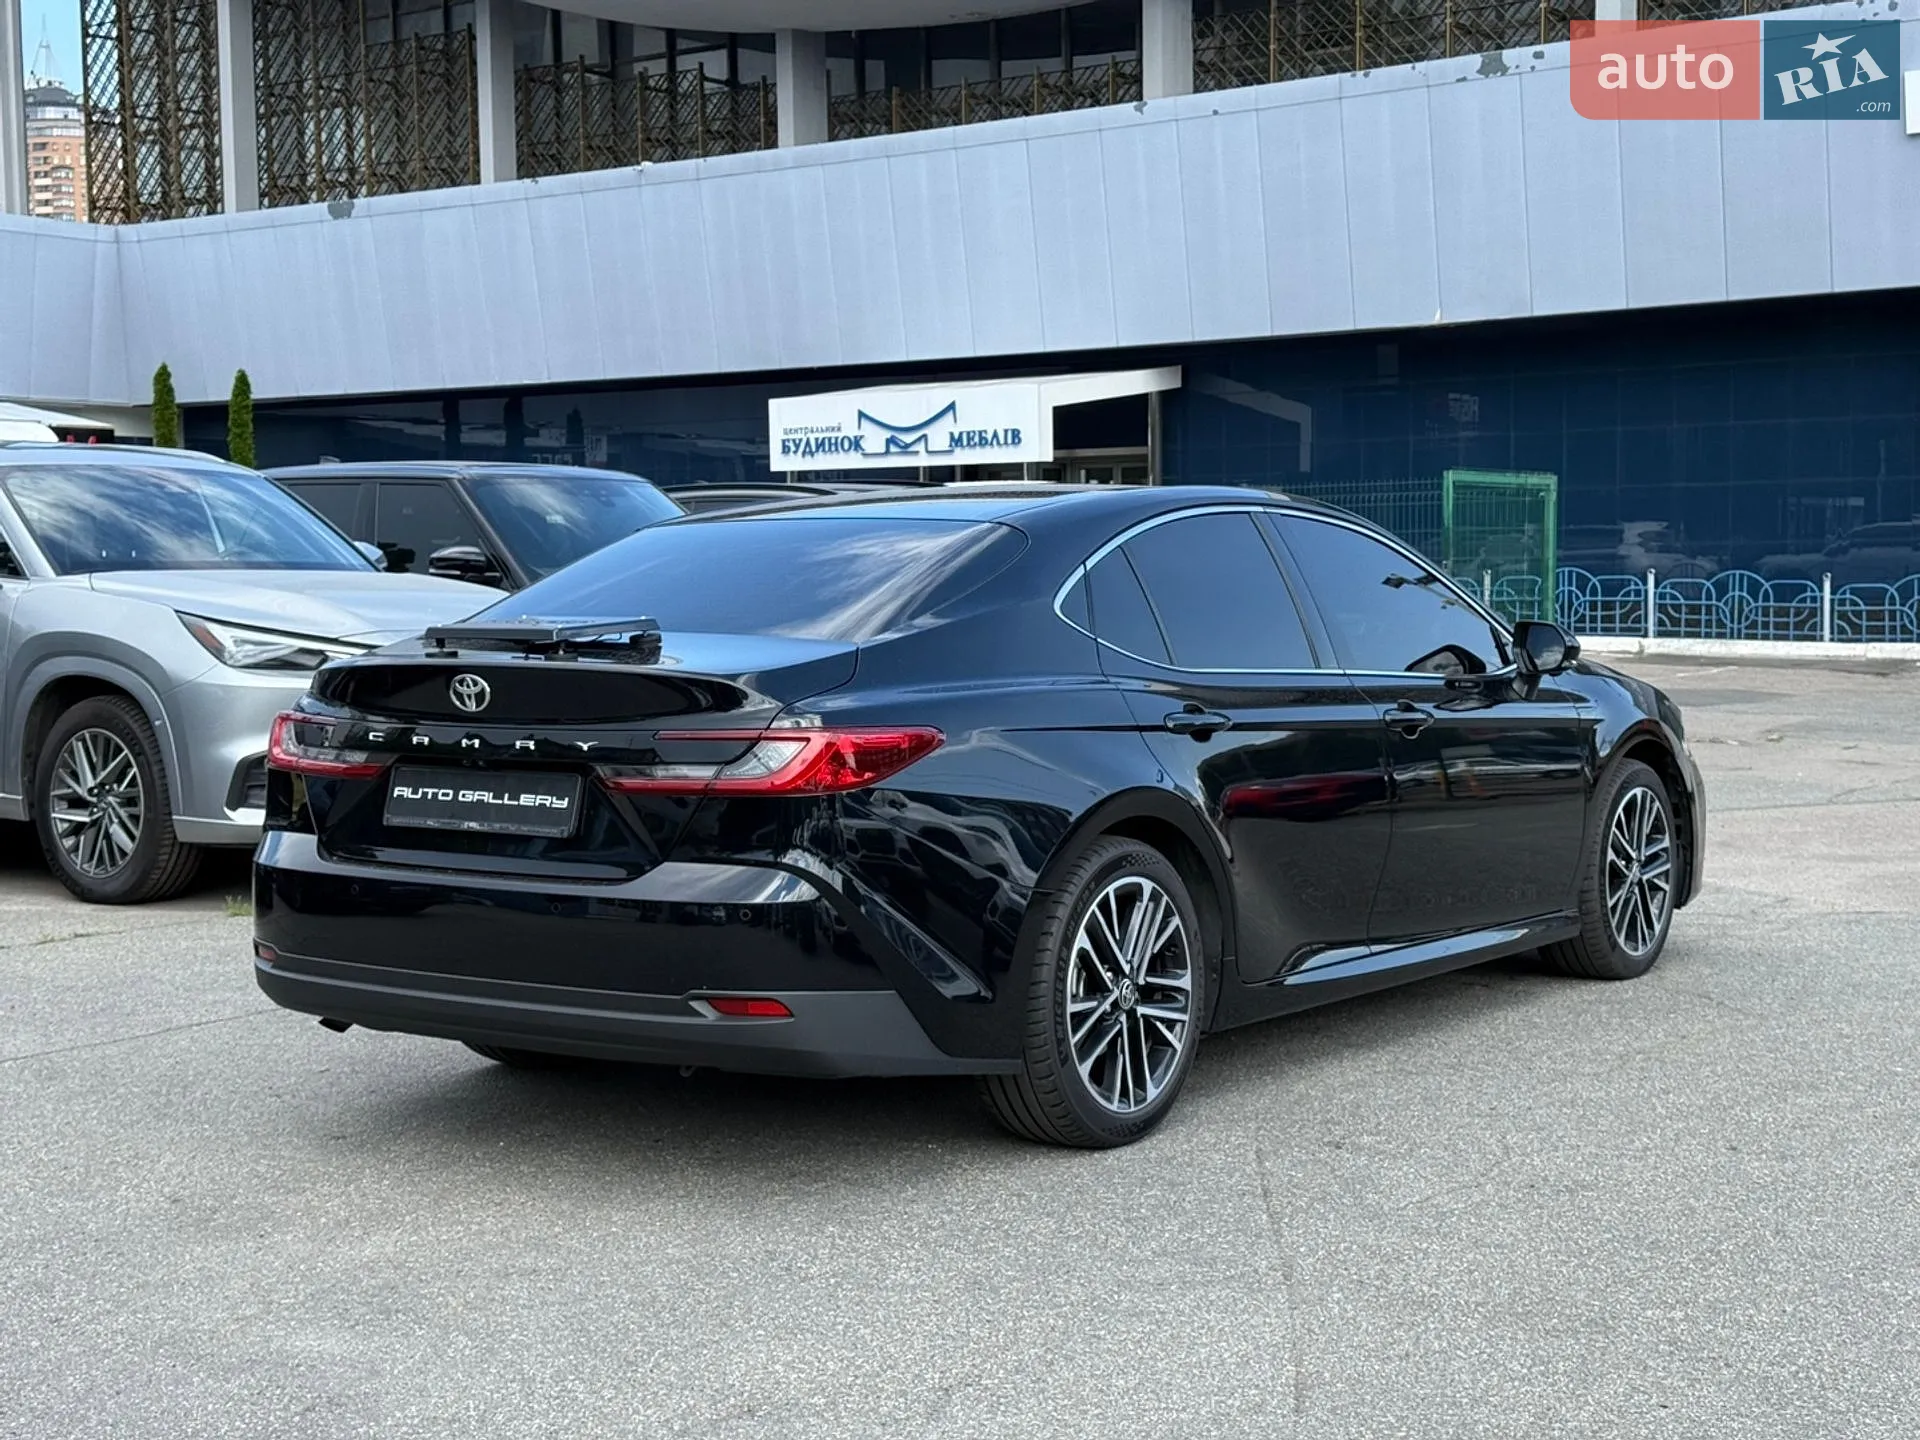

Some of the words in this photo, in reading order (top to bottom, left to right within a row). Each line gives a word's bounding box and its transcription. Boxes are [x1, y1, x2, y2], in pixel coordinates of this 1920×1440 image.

[783, 422, 842, 436] центральний
[781, 434, 865, 458] БУДИНОК
[948, 427, 1023, 449] МЕБЛІВ
[368, 732, 600, 751] CAMRY
[393, 786, 454, 802] AUTO
[458, 790, 569, 809] GALLERY
